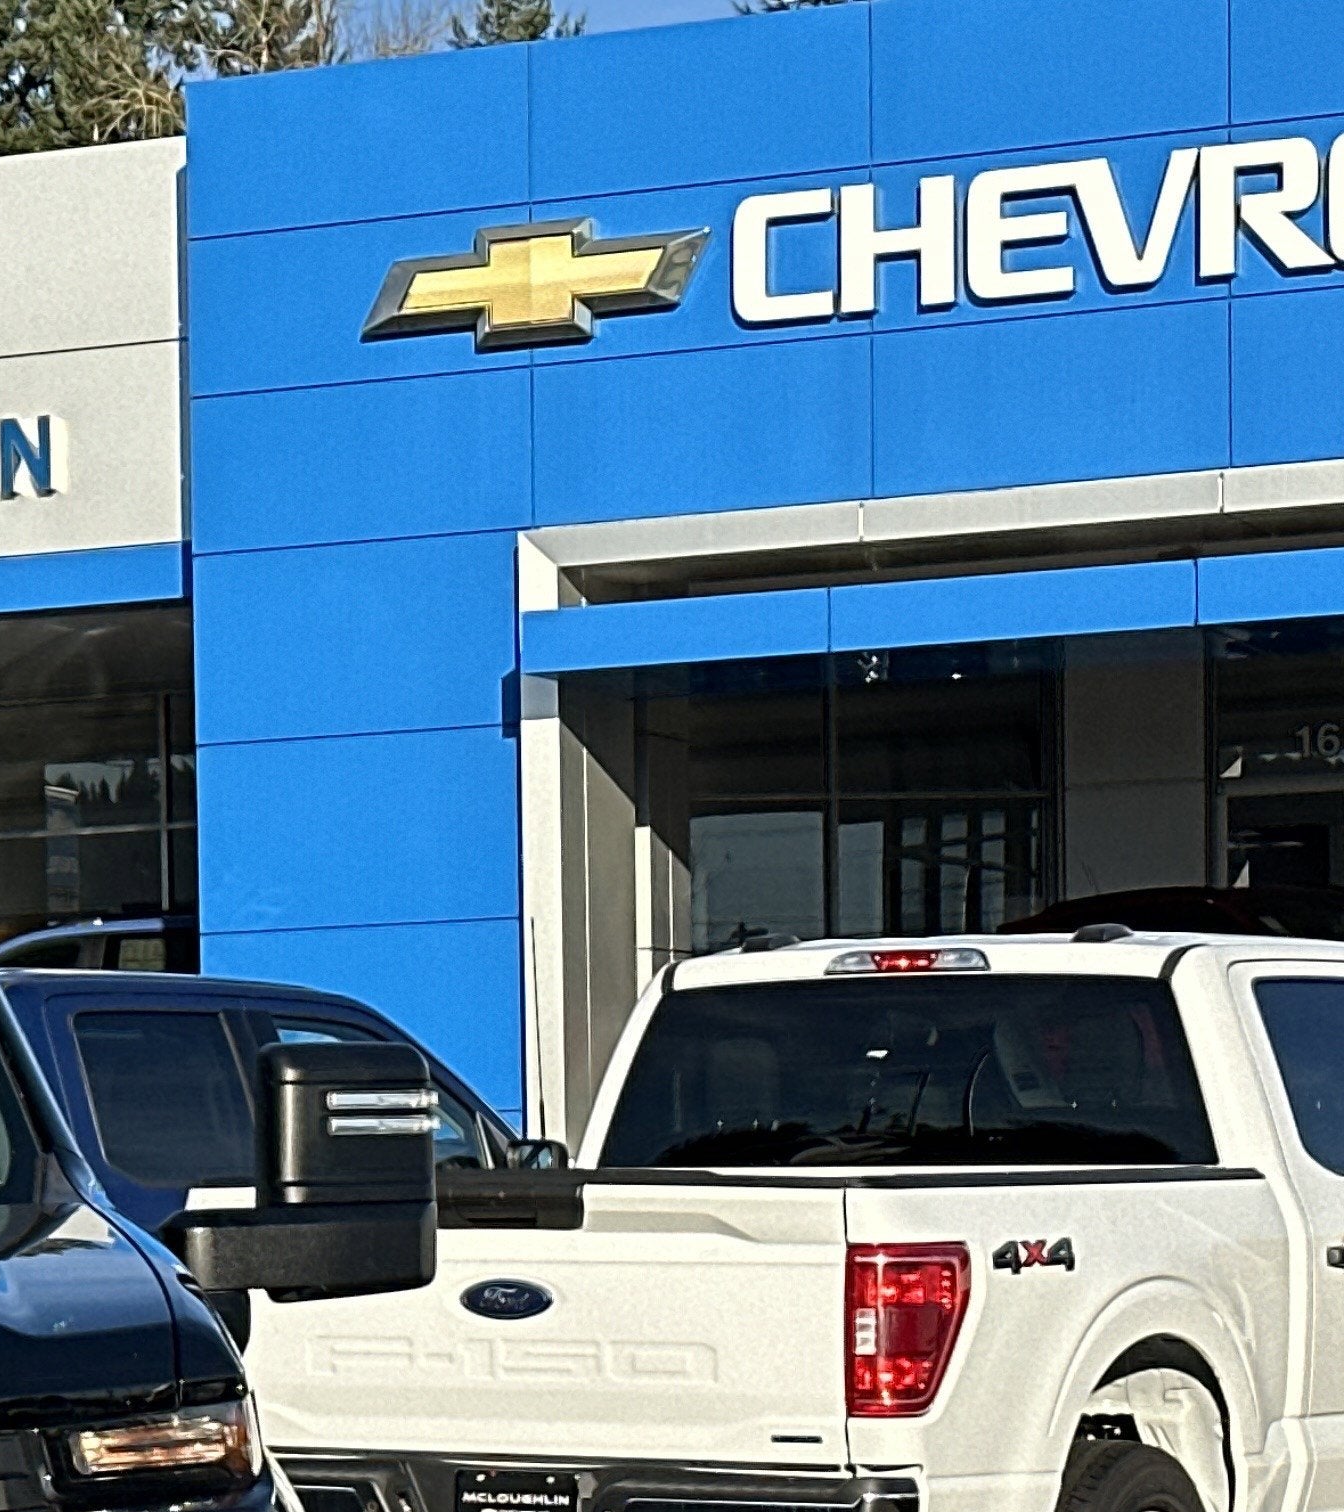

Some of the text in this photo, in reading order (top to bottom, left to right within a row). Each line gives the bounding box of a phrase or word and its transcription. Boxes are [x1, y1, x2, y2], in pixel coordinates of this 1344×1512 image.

[732, 132, 1344, 326] CHEVR
[992, 1237, 1075, 1275] 4x4
[462, 1491, 570, 1506] MCLOUGHLIN
